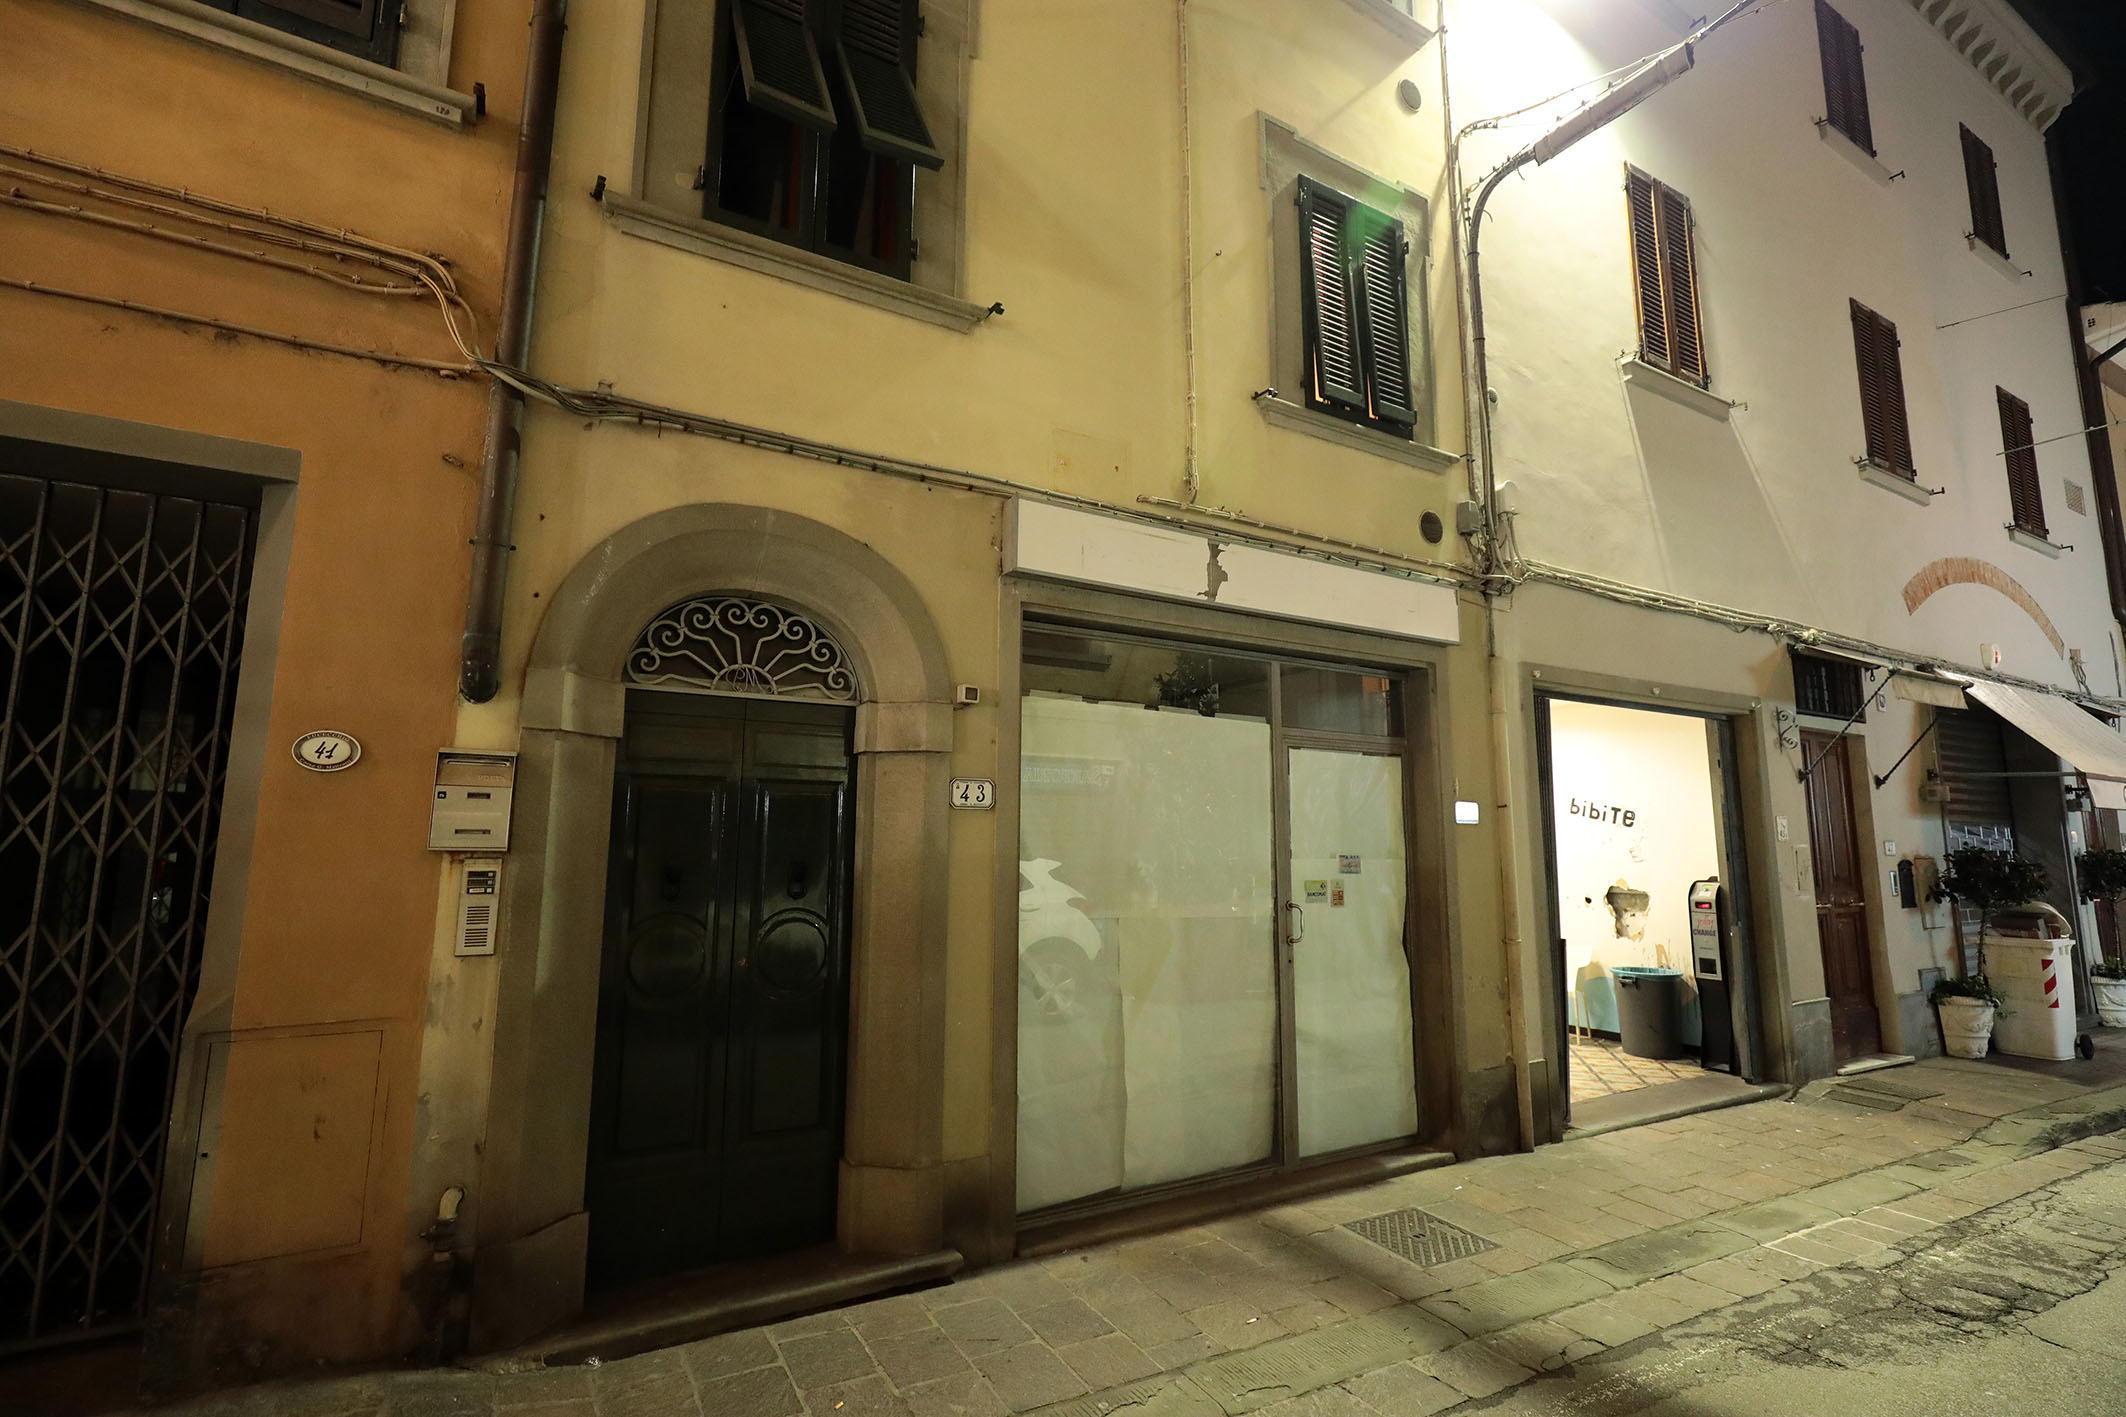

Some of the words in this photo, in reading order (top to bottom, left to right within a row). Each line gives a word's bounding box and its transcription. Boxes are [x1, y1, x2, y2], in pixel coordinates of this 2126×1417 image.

[314, 741, 339, 759] 41
[960, 784, 985, 803] 43
[1692, 928, 1717, 937] CHANGE
